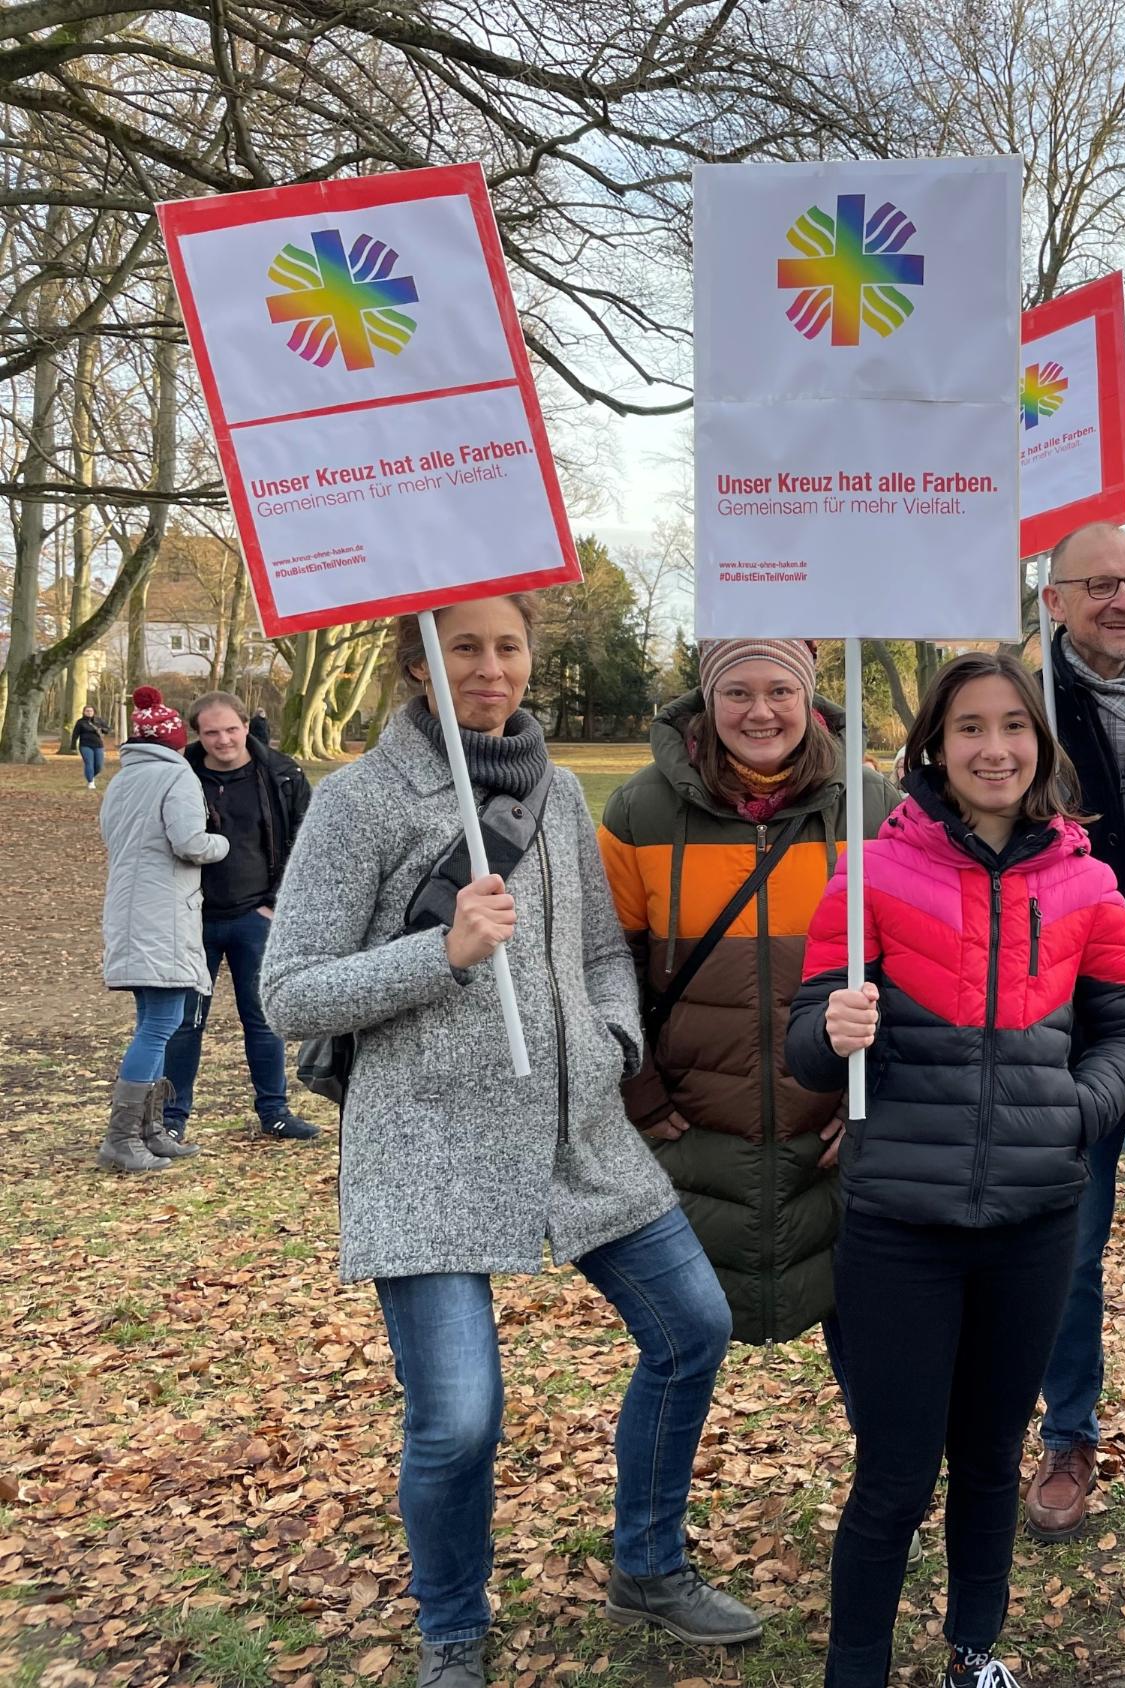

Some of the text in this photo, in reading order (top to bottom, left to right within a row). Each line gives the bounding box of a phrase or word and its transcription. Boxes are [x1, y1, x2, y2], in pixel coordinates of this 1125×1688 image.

[1027, 443, 1041, 455] hat
[1044, 437, 1060, 449] alle
[1062, 426, 1097, 442] Farben.
[250, 439, 534, 499] Unser Kreuz hat alle Farben.
[717, 470, 998, 494] Unser Kreuz hat alle Farben.
[257, 464, 508, 518] Gemeinsam für mehr Vielfalt.
[717, 496, 965, 516] Gemeinsam für mehr Vielfalt.
